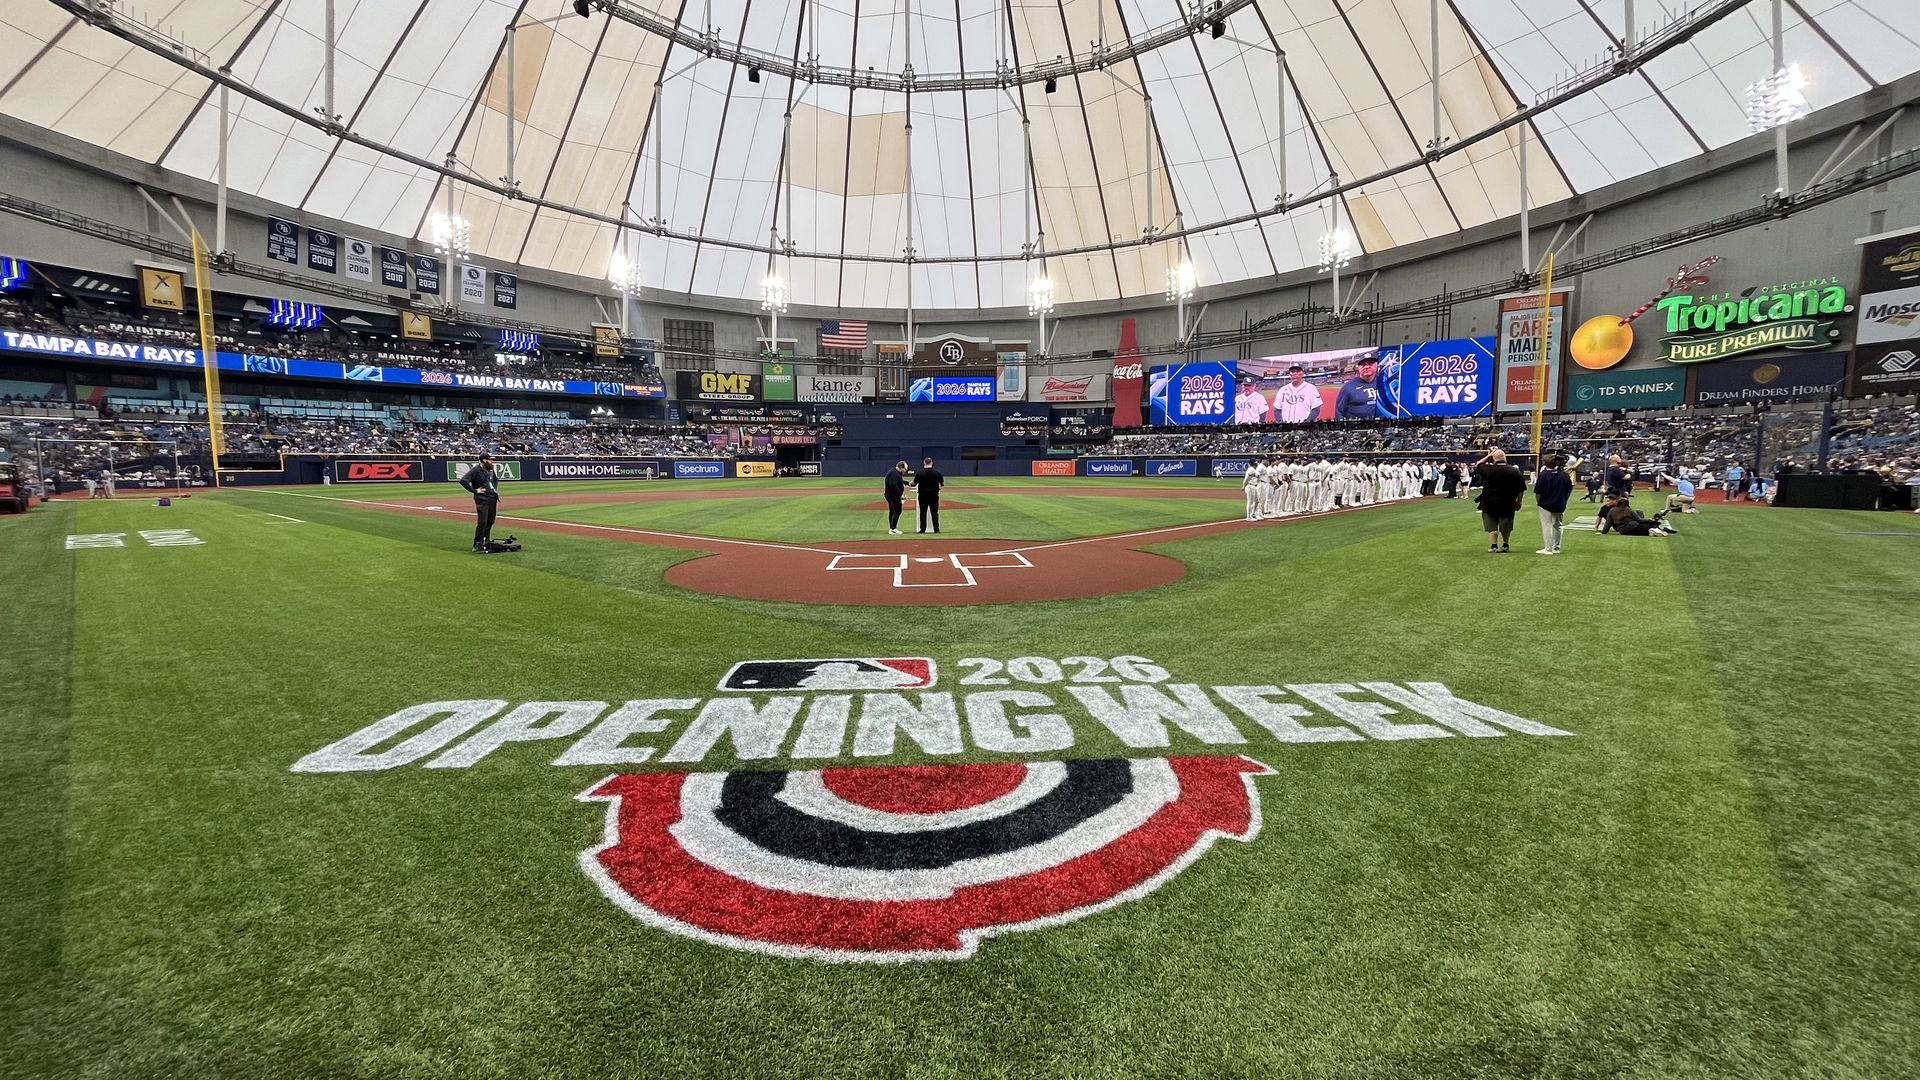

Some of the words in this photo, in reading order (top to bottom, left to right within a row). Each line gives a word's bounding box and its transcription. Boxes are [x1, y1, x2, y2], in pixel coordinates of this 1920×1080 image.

[311, 254, 333, 267] 2008
[349, 263, 369, 275] 2008
[385, 271, 404, 283] 2010
[419, 278, 437, 289] 2020
[1762, 276, 1839, 294] ORIGINAL
[464, 287, 482, 298] 2020
[497, 294, 513, 304] 2021
[1699, 292, 1731, 302] THE
[1656, 286, 1846, 333] Tropicana
[1510, 313, 1531, 321] MAJOR
[4, 331, 92, 355] TAMPA
[95, 341, 140, 359] BAY
[143, 346, 197, 364] RAYS
[1670, 342, 1717, 360] PURE
[1720, 323, 1815, 354] PREMIUM
[1508, 352, 1551, 363] PERSONL
[1419, 354, 1478, 376] 2026
[421, 371, 453, 384] 2026
[455, 374, 504, 388] TAMPA
[505, 377, 532, 389] BAY
[533, 379, 565, 392] RAYS
[701, 373, 752, 394] GMF
[1181, 374, 1224, 392] 2026
[1418, 376, 1455, 386] TAMPA
[1456, 374, 1478, 384] BAY
[937, 384, 967, 396] 2026
[967, 387, 991, 396] RAYS
[1180, 392, 1209, 400] TAMPA
[1208, 391, 1225, 399] BAY
[1417, 383, 1478, 404] RAYS
[1599, 386, 1616, 397] TD
[1618, 381, 1675, 395] SYNNEX
[1699, 390, 1740, 401] DREAM
[1742, 386, 1790, 399] FINDERS
[1281, 392, 1305, 405] RAYS
[1180, 399, 1225, 415] RAYS
[348, 463, 412, 479] DEX
[679, 464, 717, 475] Spectrum
[1103, 463, 1127, 472] Webull
[957, 655, 1172, 687] 2026
[290, 690, 1075, 772] OPENING
[1064, 682, 1574, 748] WEEK
